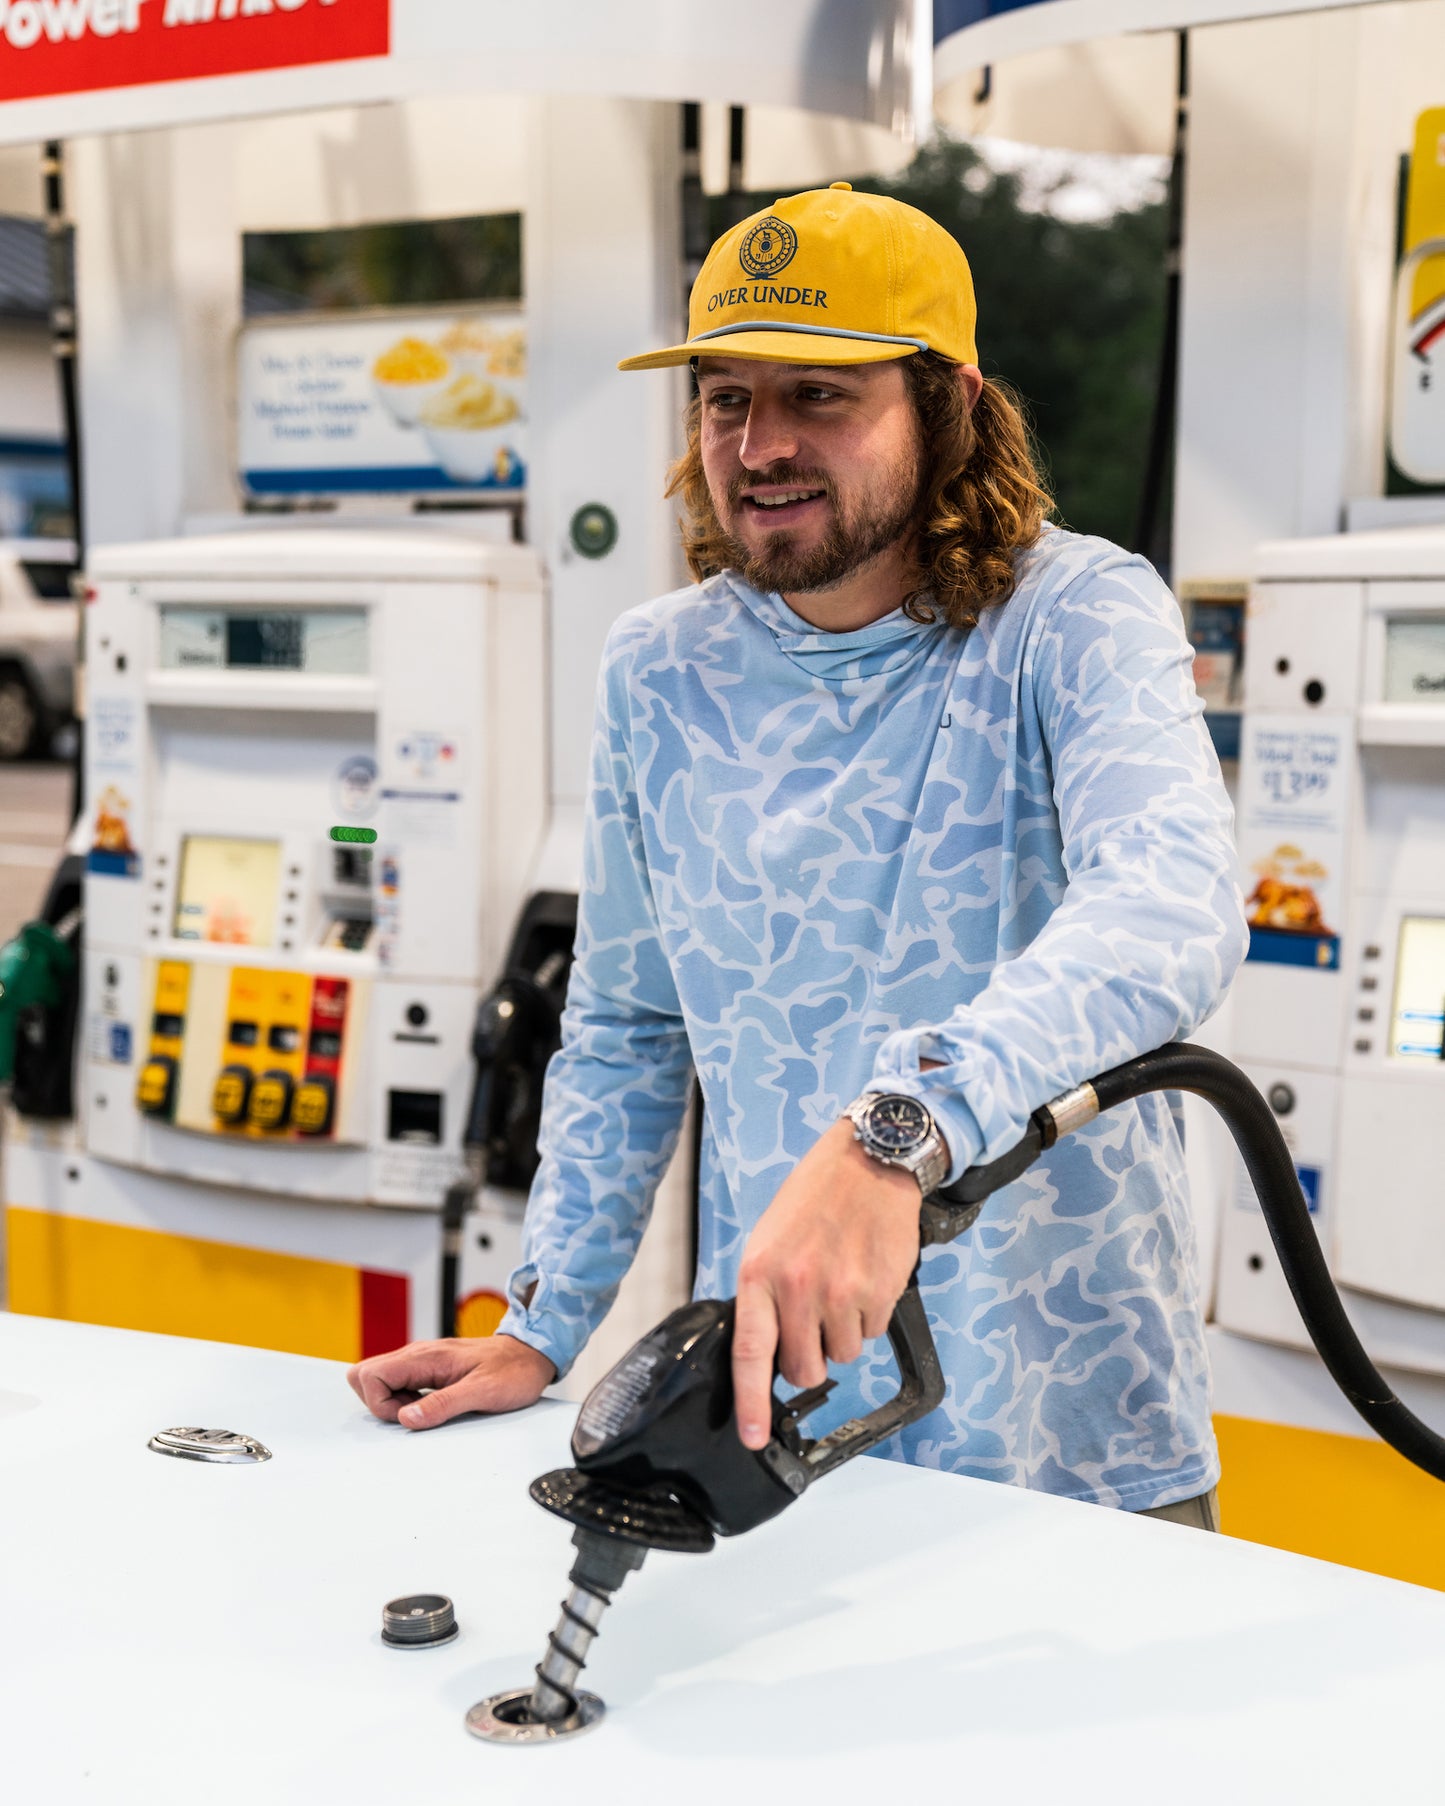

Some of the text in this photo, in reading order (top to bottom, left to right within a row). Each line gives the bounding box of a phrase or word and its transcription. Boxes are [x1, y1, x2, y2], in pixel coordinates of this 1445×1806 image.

[0, 0, 141, 49] ower
[708, 286, 828, 312] OVER UNDER
